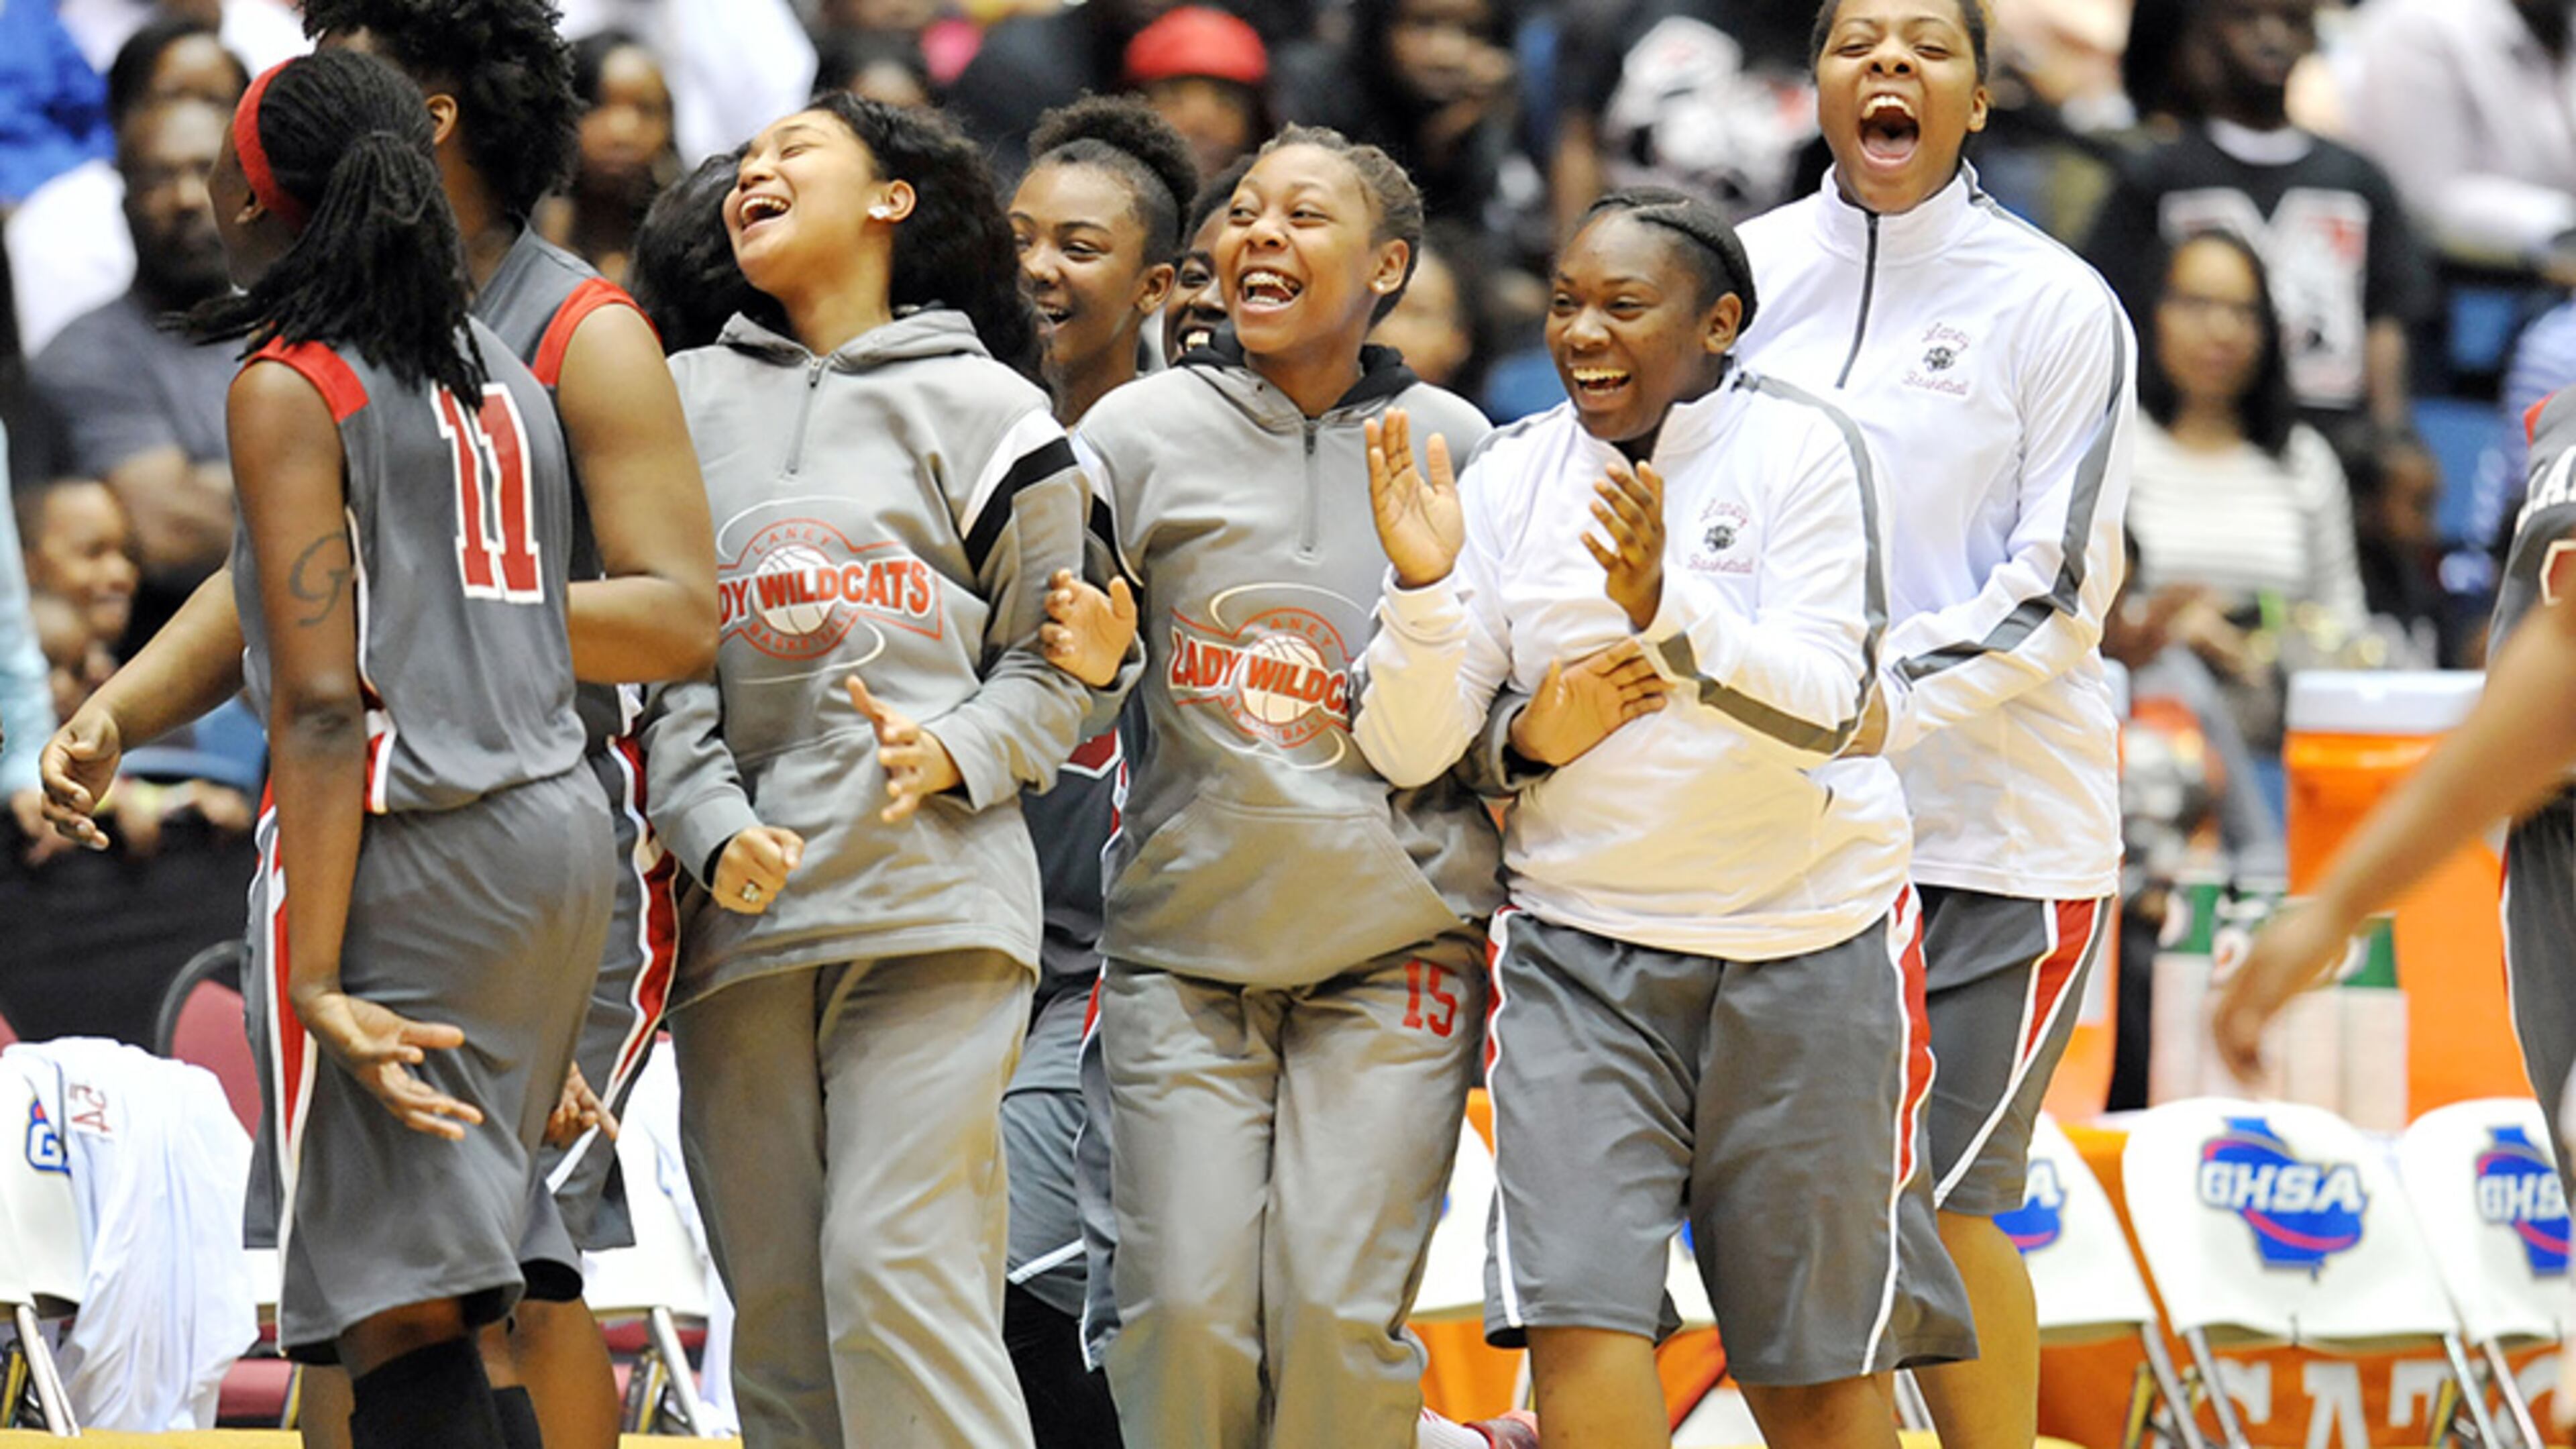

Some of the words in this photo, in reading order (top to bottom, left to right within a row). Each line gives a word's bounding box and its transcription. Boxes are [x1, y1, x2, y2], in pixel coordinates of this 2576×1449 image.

[430, 380, 545, 604] 11
[753, 527, 832, 555] LANEY
[717, 578, 750, 626] DY
[755, 559, 931, 615] WILDCATS
[1171, 631, 1243, 688] LADY
[1245, 655, 1350, 715] WILDC
[1402, 957, 1457, 1038] 15
[2200, 1161, 2363, 1213] GHSA
[2478, 1173, 2569, 1218] GHS
